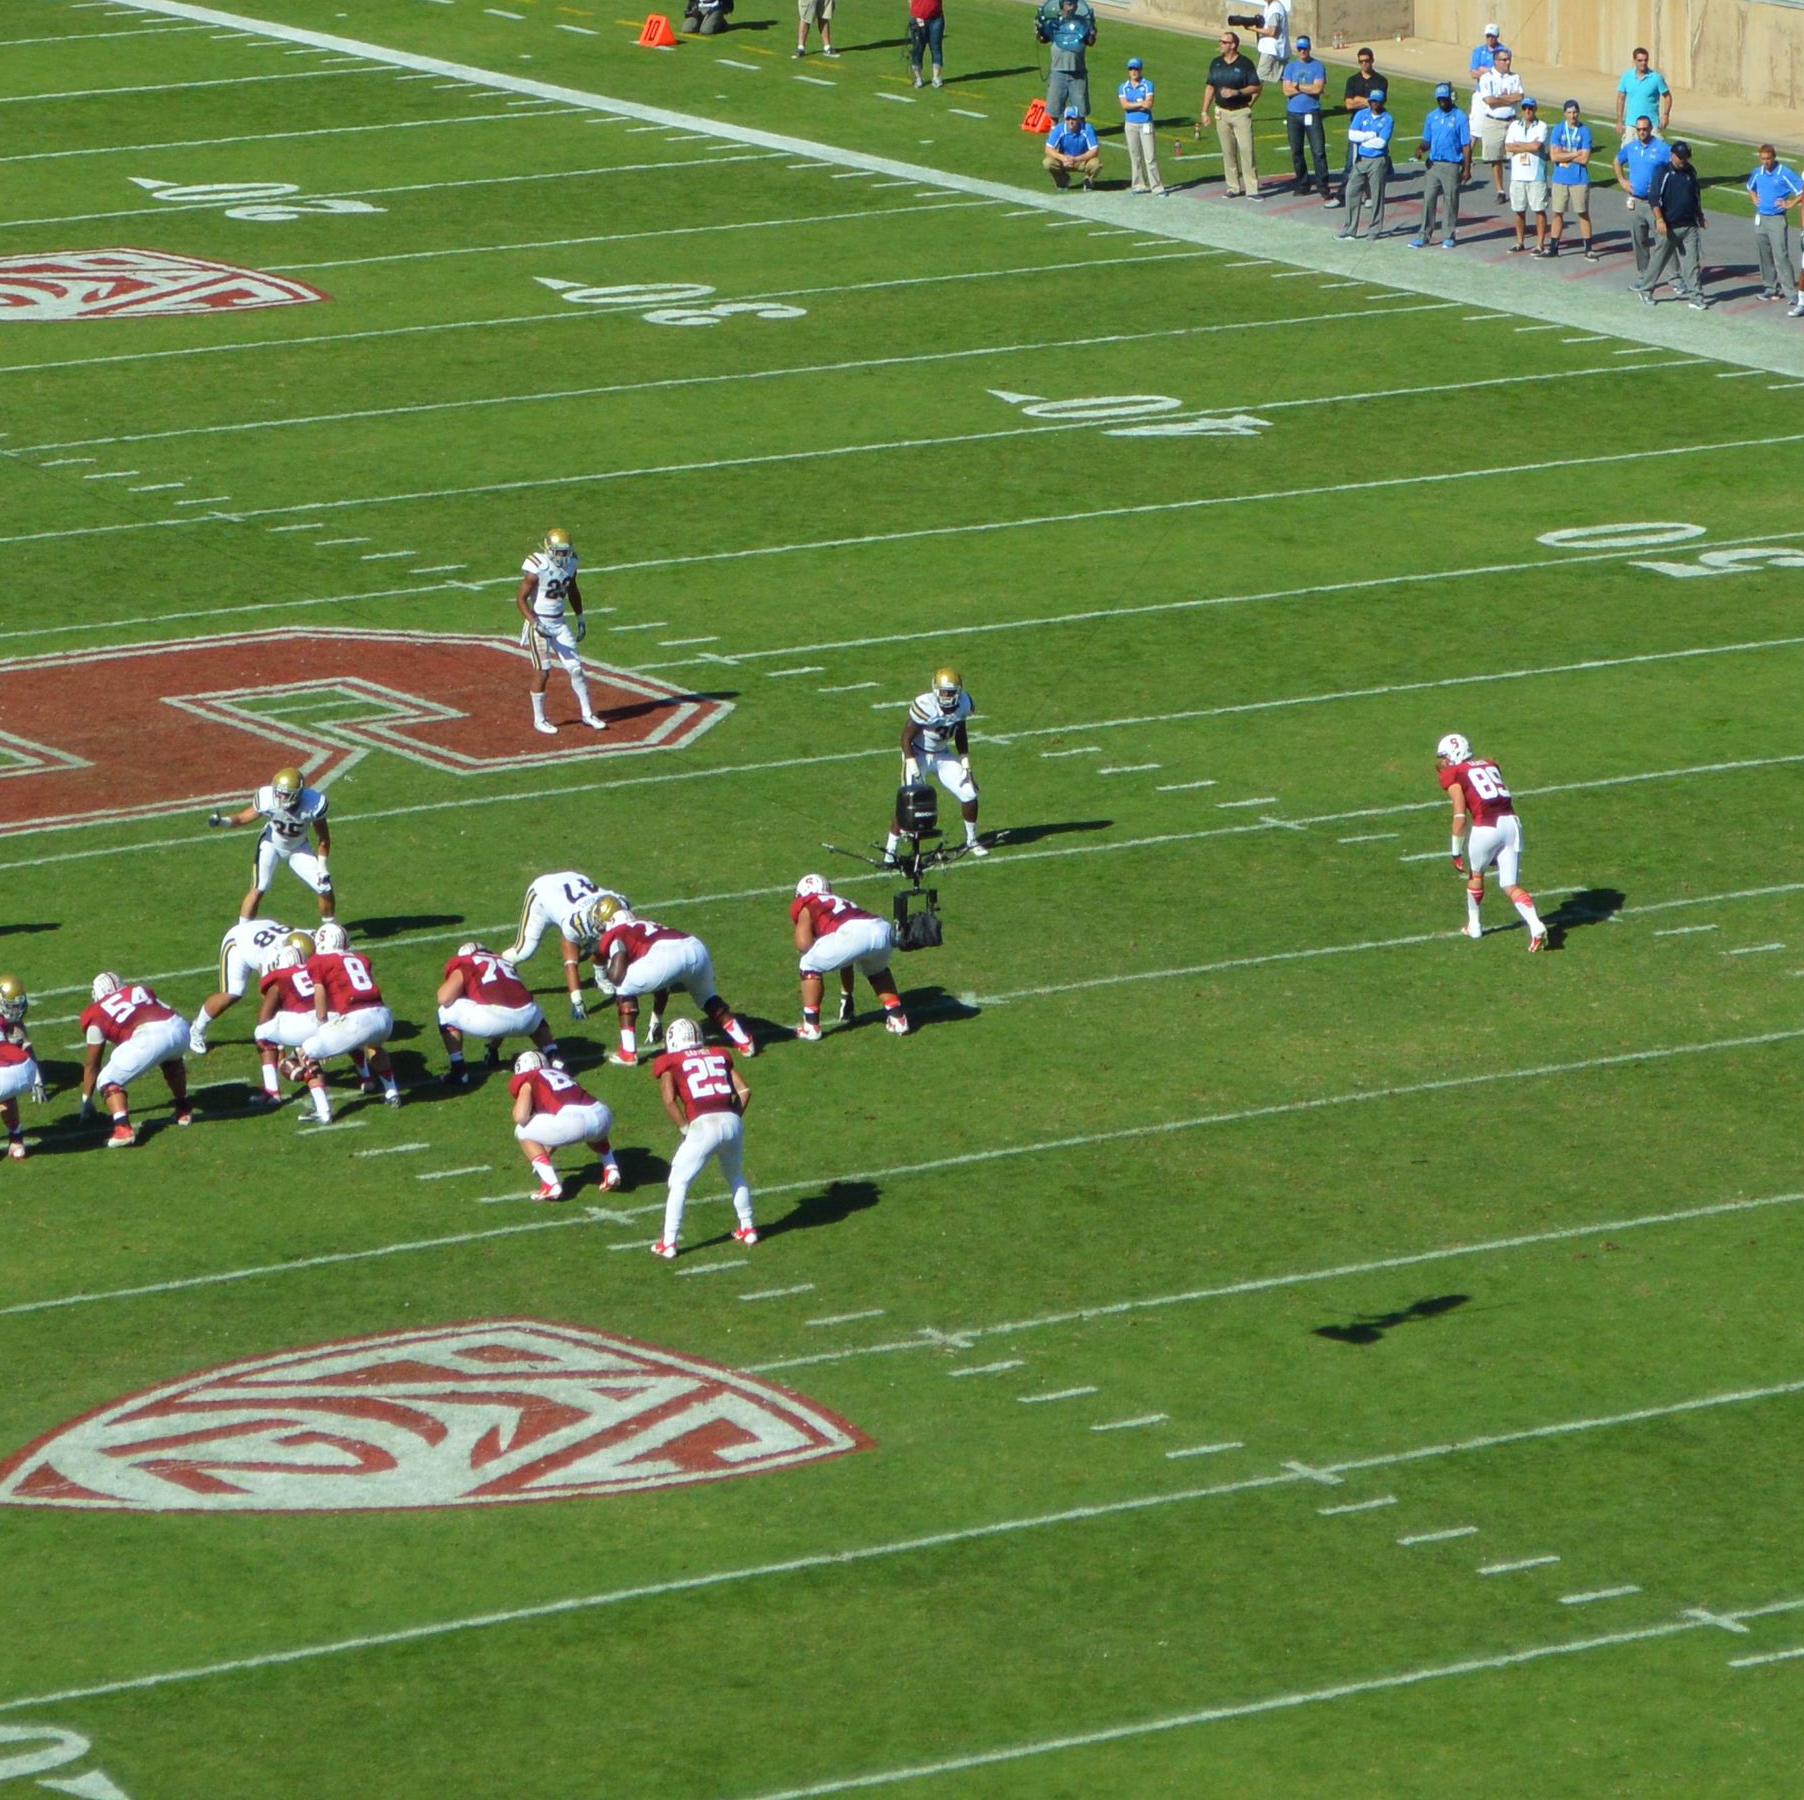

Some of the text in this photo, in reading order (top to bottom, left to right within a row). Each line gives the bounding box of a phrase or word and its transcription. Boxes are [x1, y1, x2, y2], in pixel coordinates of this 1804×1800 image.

[643, 19, 659, 41] 10
[1024, 104, 1045, 128] 20
[342, 957, 375, 993] 8
[100, 984, 159, 1023] 54
[682, 1055, 732, 1099] 25
